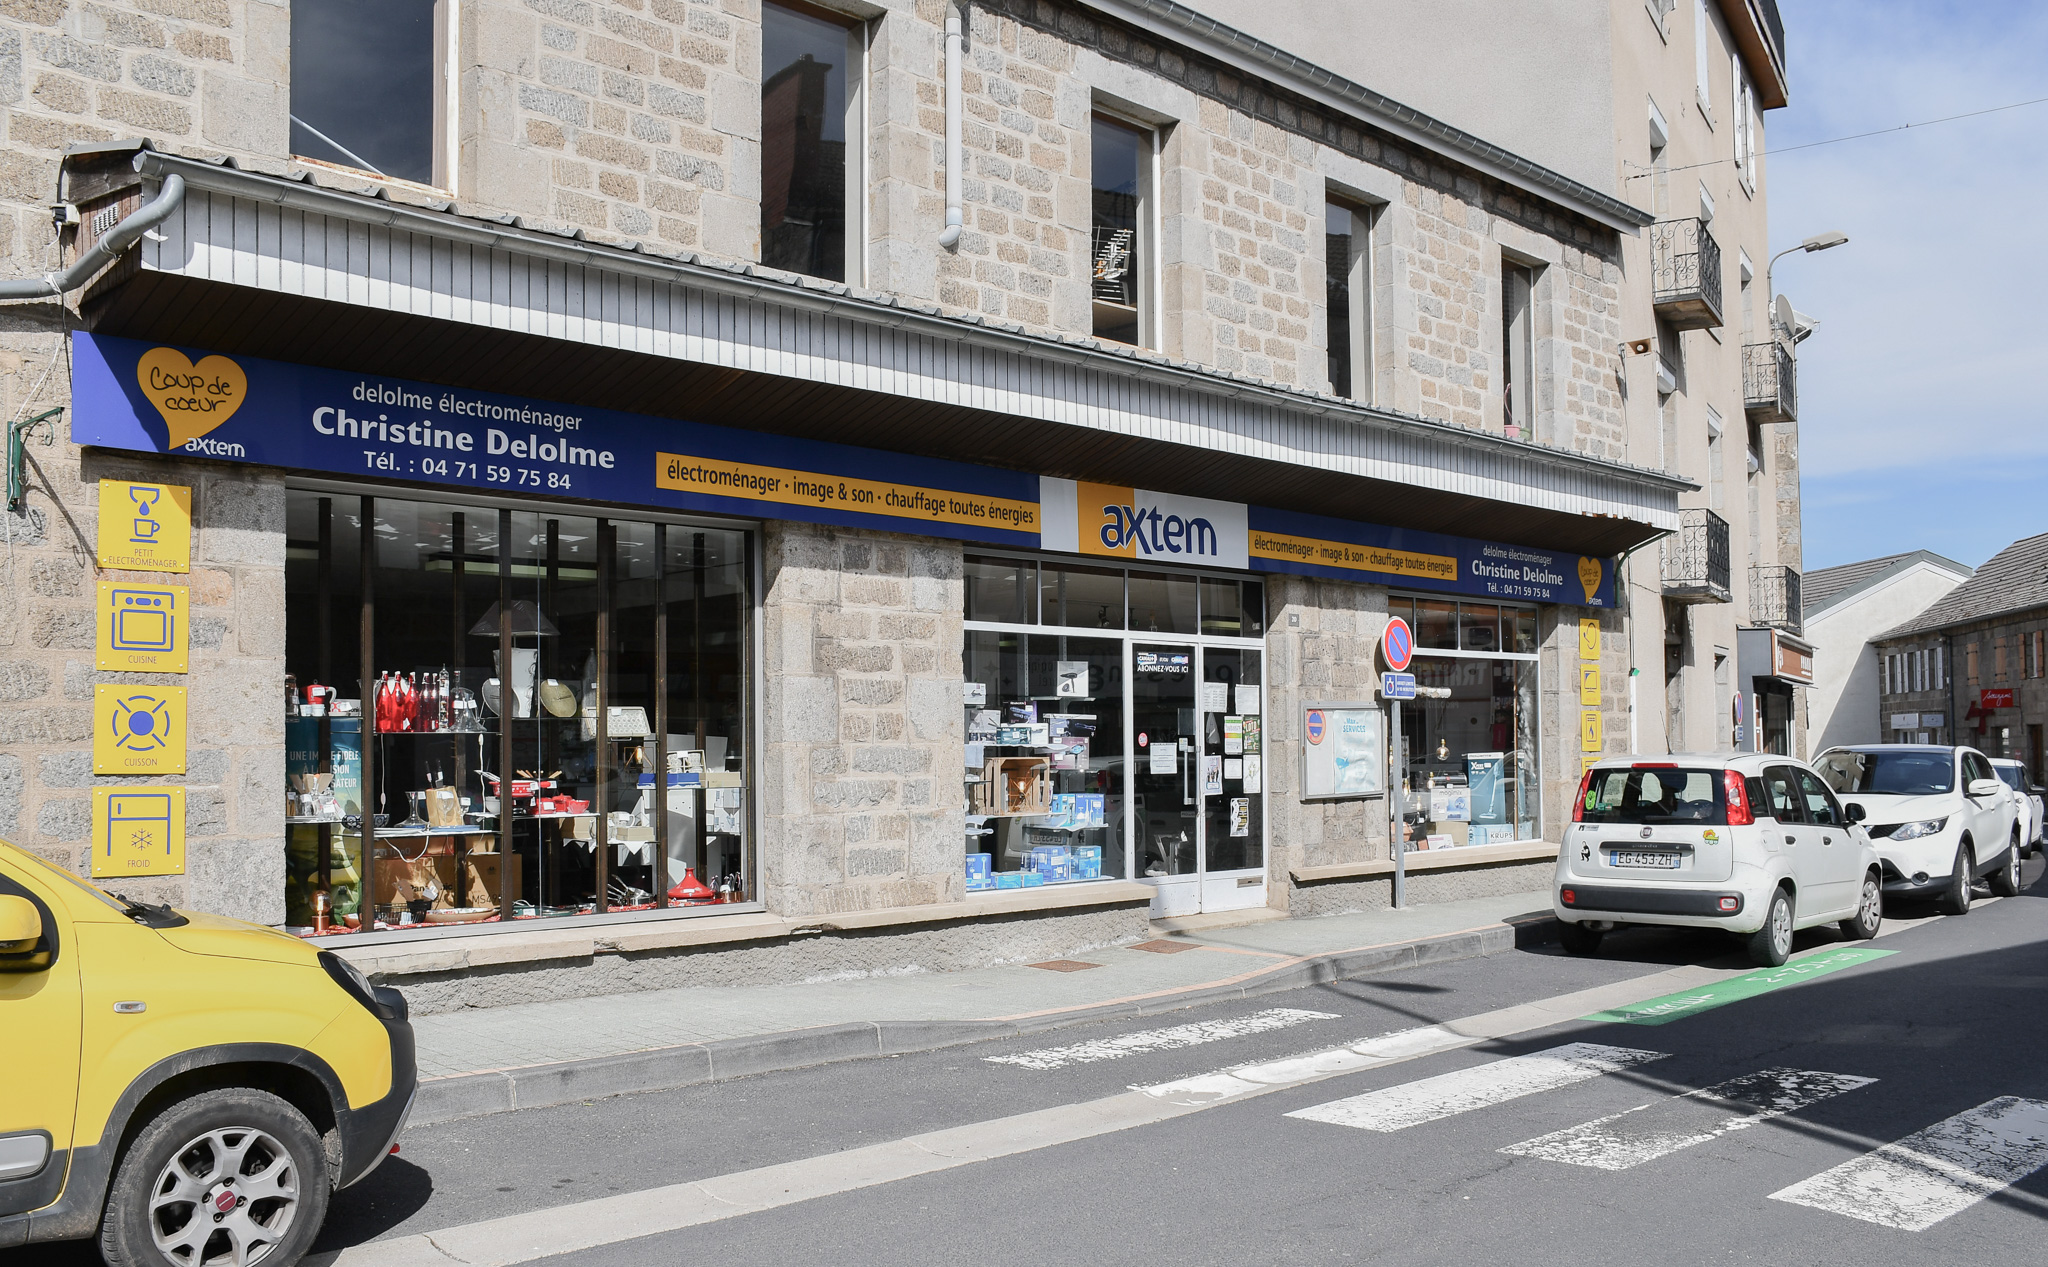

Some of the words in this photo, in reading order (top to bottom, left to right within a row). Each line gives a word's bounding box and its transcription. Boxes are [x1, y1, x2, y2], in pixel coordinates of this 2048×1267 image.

[150, 366, 204, 395] Coup
[207, 376, 232, 396] de
[352, 382, 432, 410] delolme
[439, 393, 582, 432] électroménager
[185, 437, 245, 457] axtem
[312, 407, 473, 452] Christine
[487, 429, 615, 468] Delolme
[364, 451, 400, 472] Tél.
[422, 458, 448, 476] 04
[455, 462, 477, 479] 71
[487, 465, 510, 483] 59
[518, 469, 541, 486] 75
[548, 472, 571, 490] 84
[668, 459, 780, 495] électroménager
[793, 476, 834, 502] image
[838, 483, 848, 500] &
[851, 488, 873, 503] son
[885, 489, 946, 516] chauffage
[949, 498, 985, 517] toutes
[989, 502, 1034, 526] énergies
[1100, 504, 1217, 556] axtem
[108, 556, 177, 568] ELECTROMENAGER
[134, 548, 154, 557] PETIT
[1254, 535, 1314, 559] électroménager
[1320, 544, 1343, 563] image
[1344, 548, 1350, 561] &
[1351, 551, 1364, 563] son
[1370, 552, 1403, 571] chauffage
[1405, 558, 1426, 569] toutes
[1427, 558, 1453, 576] énergies
[1483, 545, 1507, 559] delolme
[1508, 548, 1552, 566] électroménager
[1471, 560, 1520, 580] Christine
[1523, 567, 1563, 585] Delolme
[1487, 583, 1498, 593] Tél.
[1504, 585, 1513, 595] 04
[1514, 586, 1522, 595] 71
[1524, 586, 1532, 596] 59
[1533, 587, 1541, 597] 75
[1542, 588, 1550, 598] 84
[128, 655, 157, 664] CUISINE
[124, 758, 158, 767] CUISSON
[290, 751, 307, 760] UNE
[309, 750, 335, 760] IME
[337, 748, 359, 760] FIDÈLE
[127, 859, 151, 868] FROID
[1618, 853, 1673, 866] EG-453-ZH
